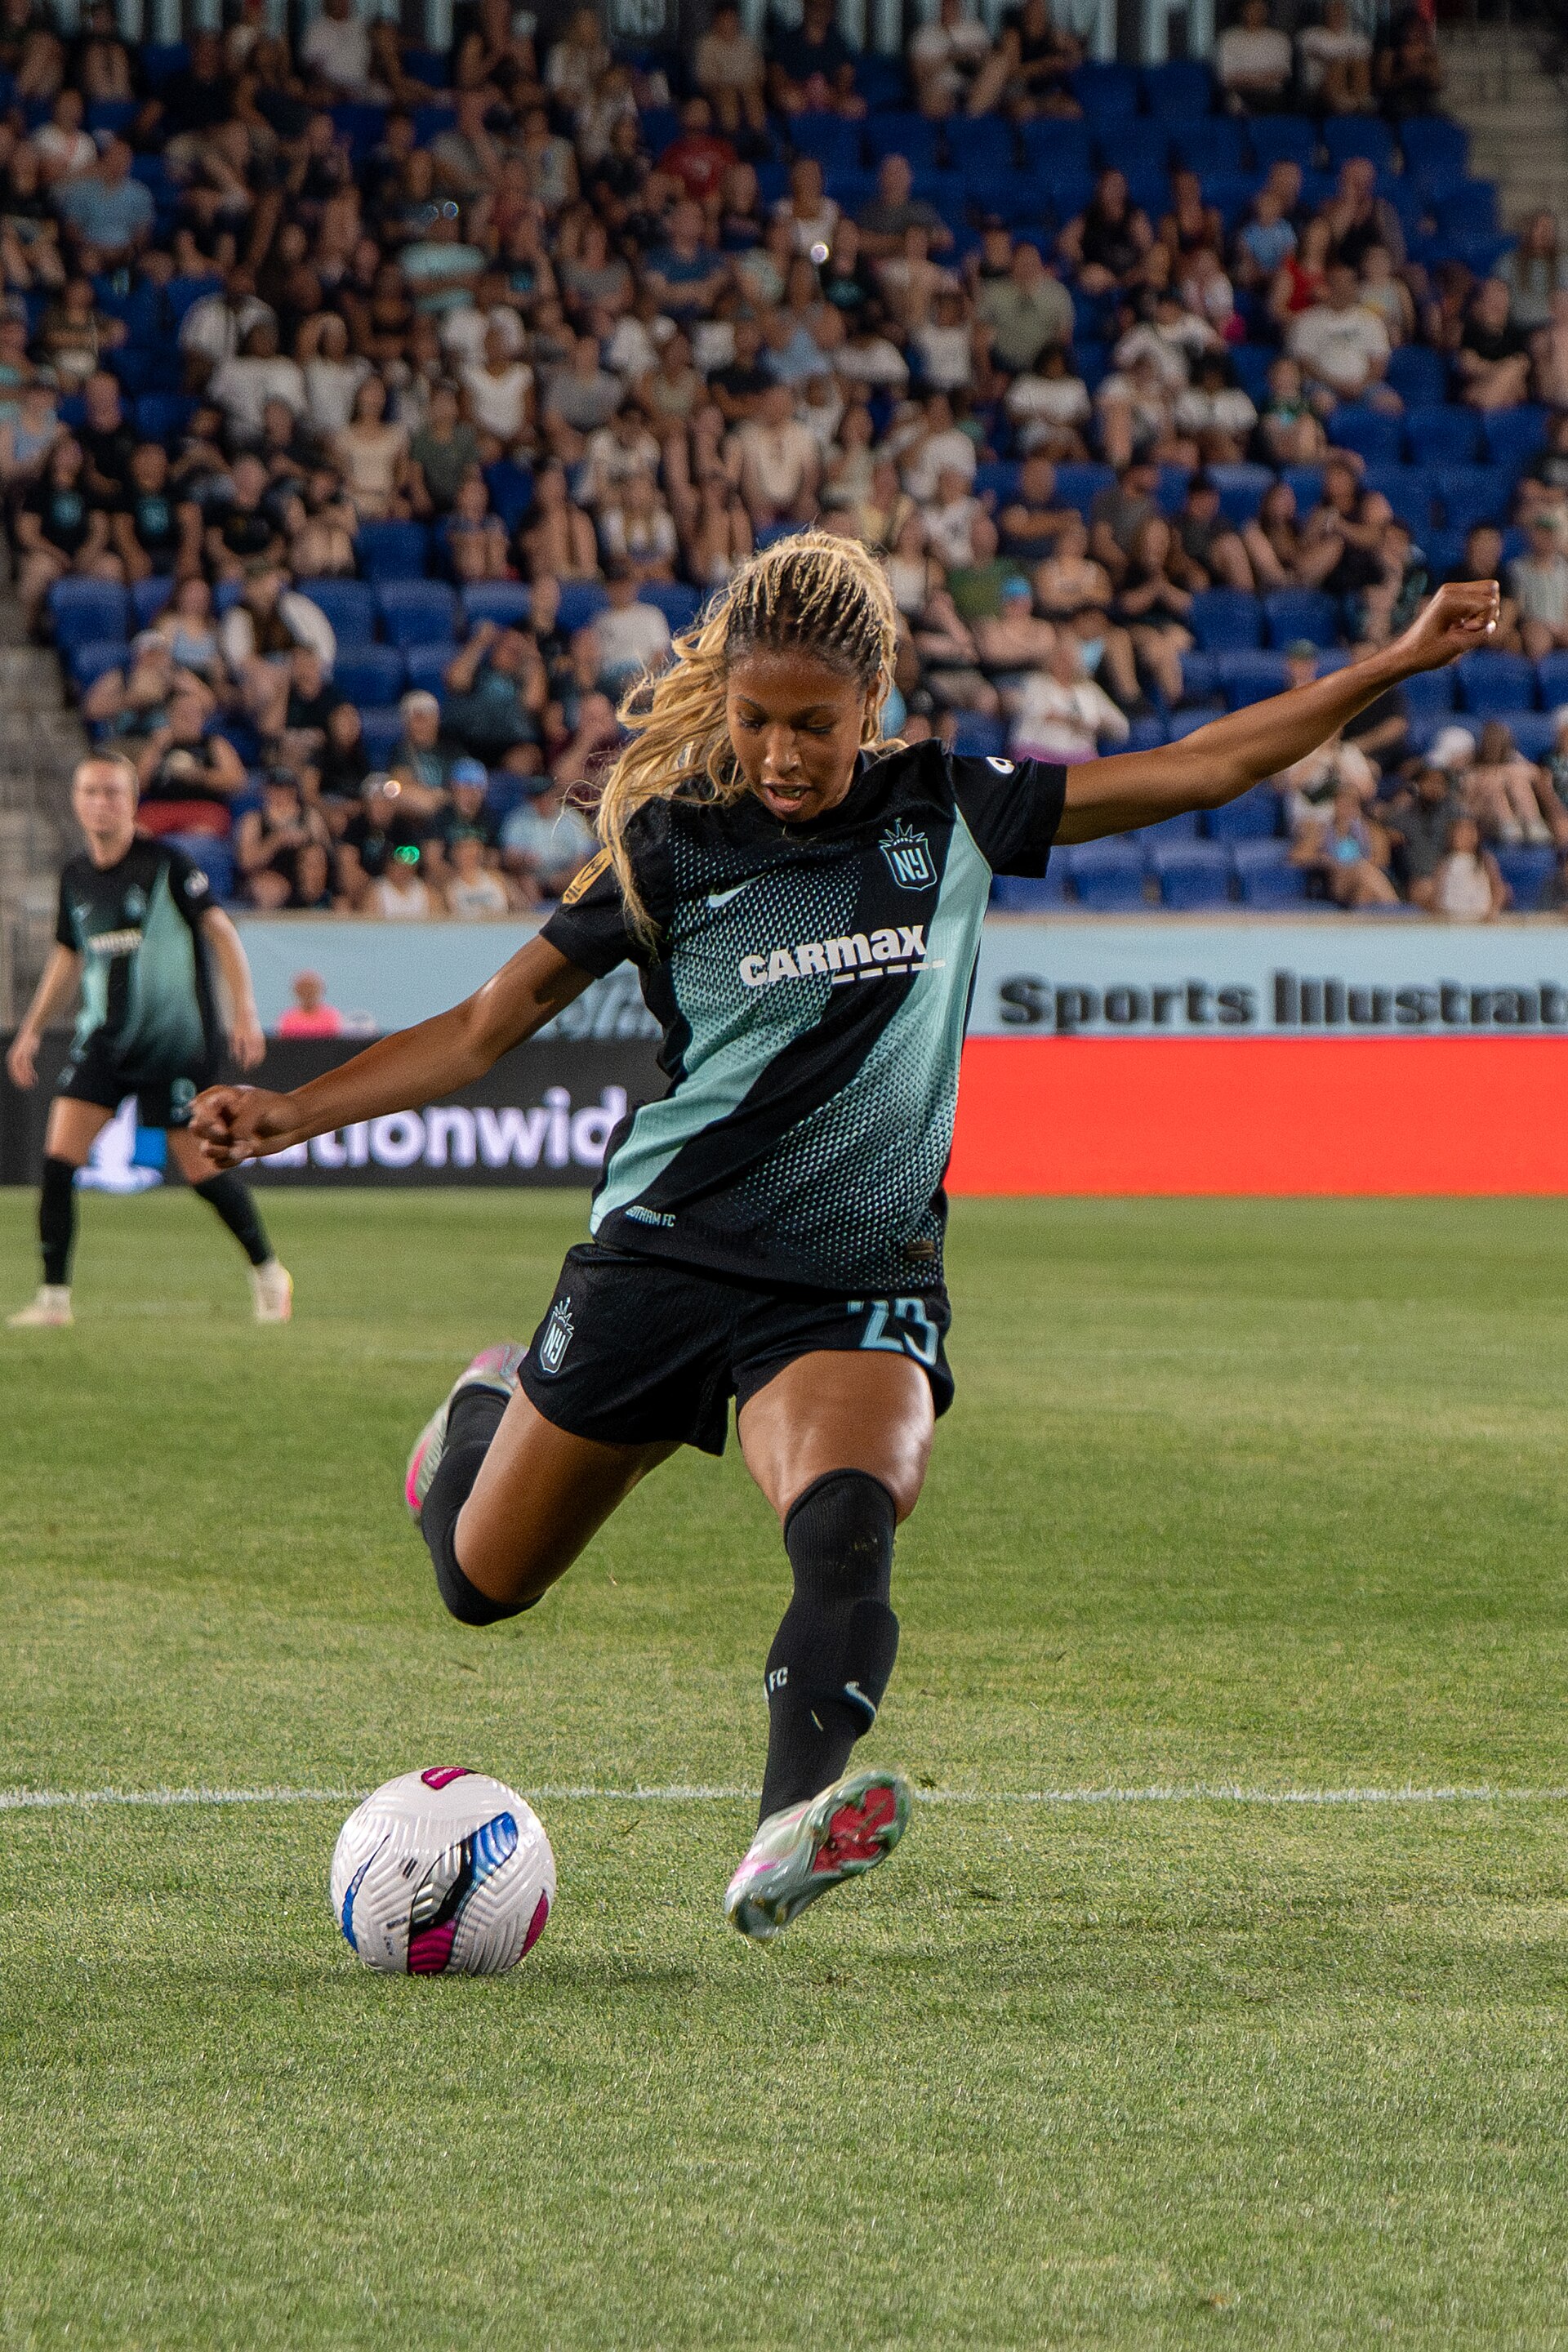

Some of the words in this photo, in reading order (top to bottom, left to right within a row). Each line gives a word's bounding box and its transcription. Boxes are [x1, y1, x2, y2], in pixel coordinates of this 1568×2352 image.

[891, 847, 929, 882] NY
[998, 972, 1255, 1038] Sports
[662, 1214, 676, 1227] FC
[847, 1297, 939, 1366] 23
[768, 1666, 789, 1693] FC
